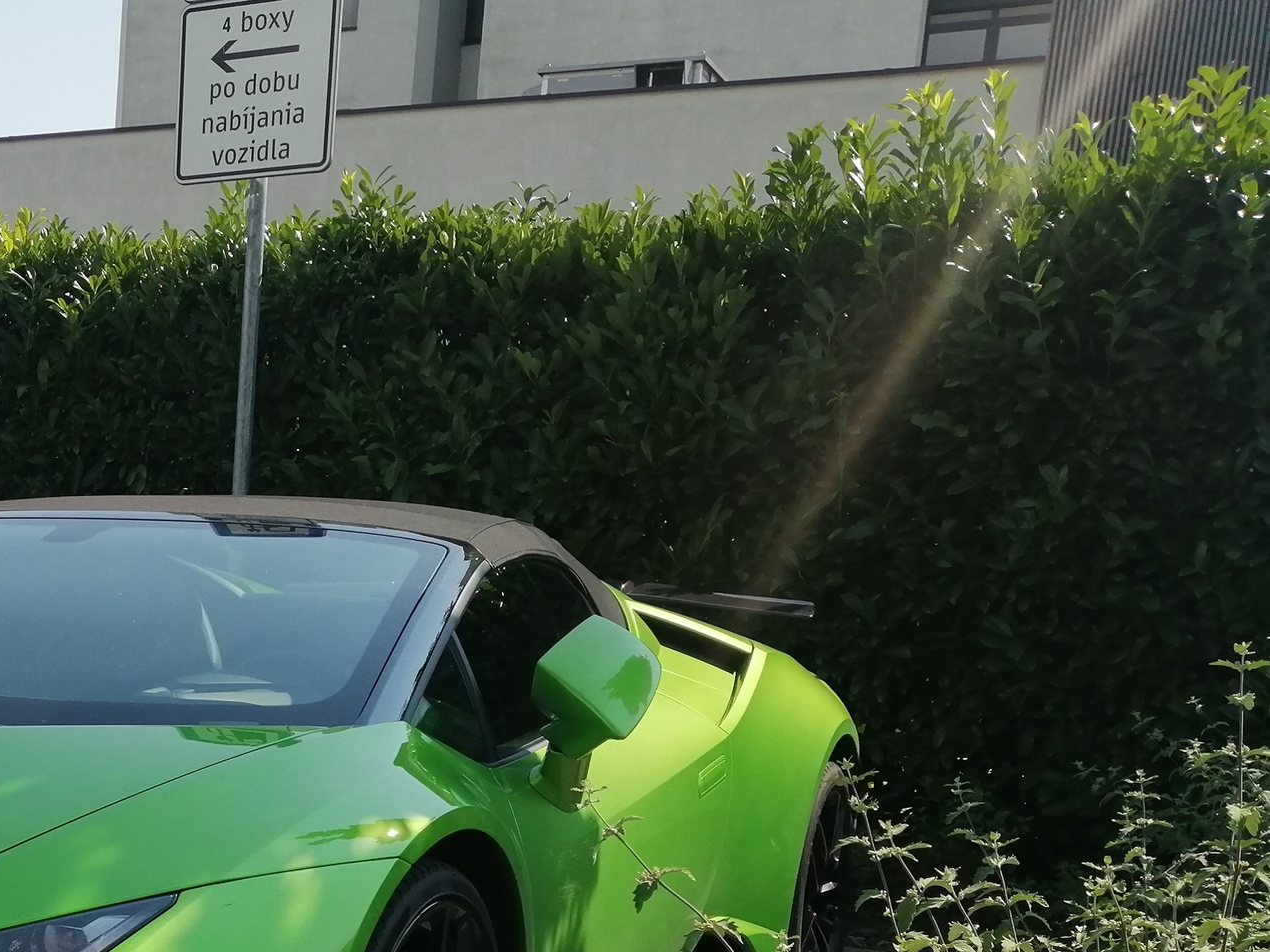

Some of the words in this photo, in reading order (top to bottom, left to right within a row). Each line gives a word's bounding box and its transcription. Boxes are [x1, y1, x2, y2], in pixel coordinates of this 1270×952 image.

[222, 16, 231, 33] 4
[241, 9, 295, 33] boxy
[209, 81, 236, 105] po
[244, 70, 300, 96] dobu
[202, 101, 305, 135] nabíjania
[212, 138, 290, 166] vozidla
